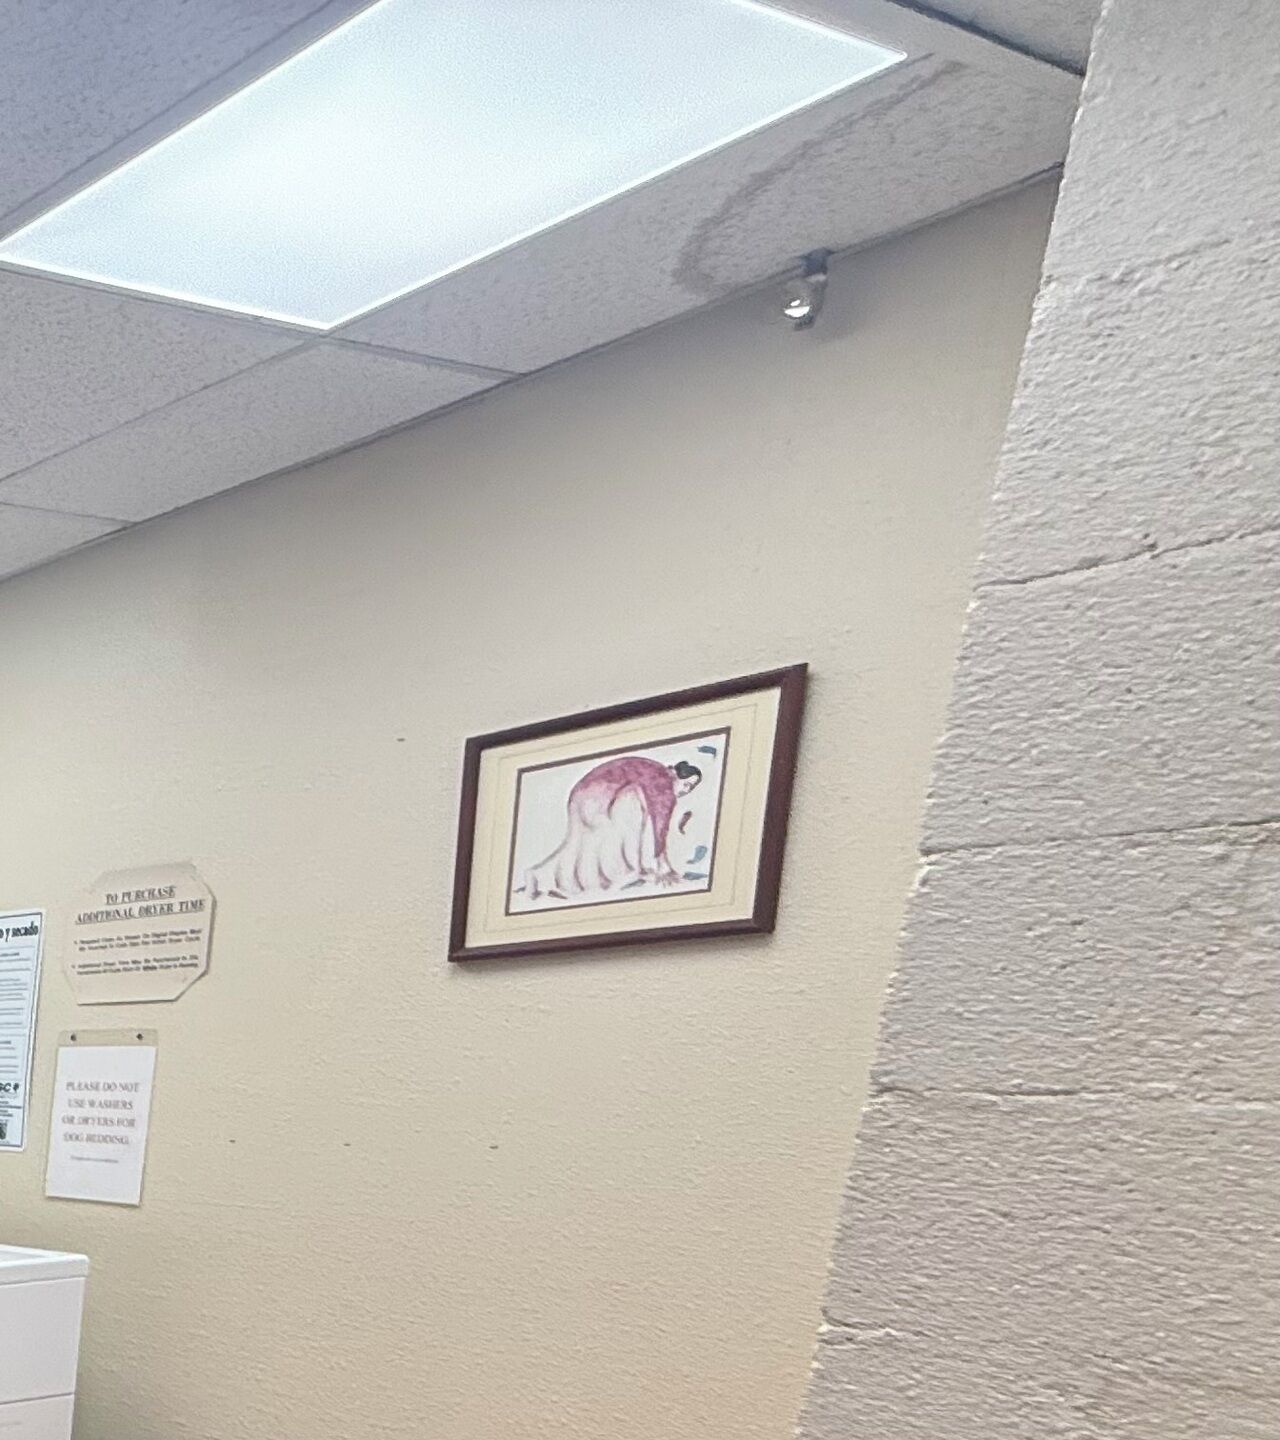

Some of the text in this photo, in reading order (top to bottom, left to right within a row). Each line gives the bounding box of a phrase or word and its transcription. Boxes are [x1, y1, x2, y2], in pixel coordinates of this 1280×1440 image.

[121, 886, 176, 901] PURCHASE
[77, 900, 206, 923] ADDITIONAL DRYER TIME
[66, 1082, 140, 1092] PLEASE DO NOT
[68, 1099, 133, 1109] USE WASHERS
